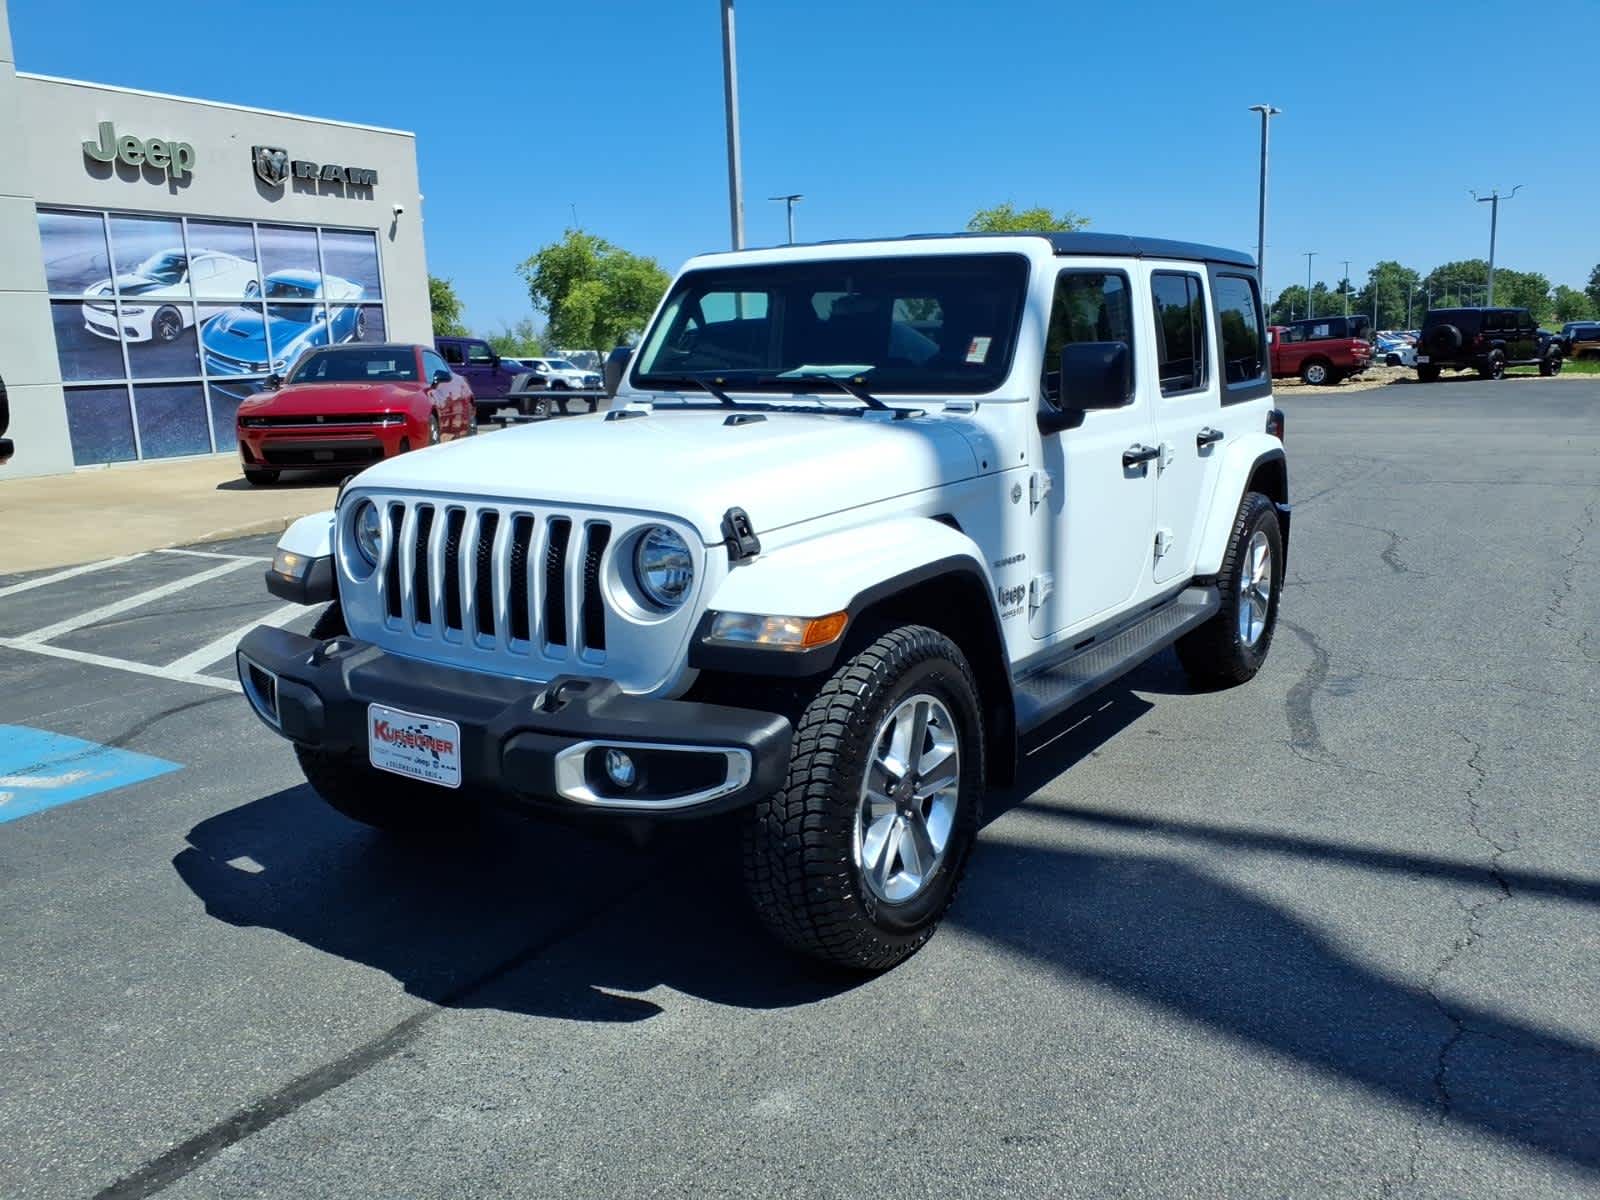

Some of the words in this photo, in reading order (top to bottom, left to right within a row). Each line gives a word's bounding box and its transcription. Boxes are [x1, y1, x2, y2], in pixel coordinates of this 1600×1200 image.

[82, 121, 196, 178] Jeep
[291, 160, 379, 185] RAM
[998, 584, 1026, 607] Jeep
